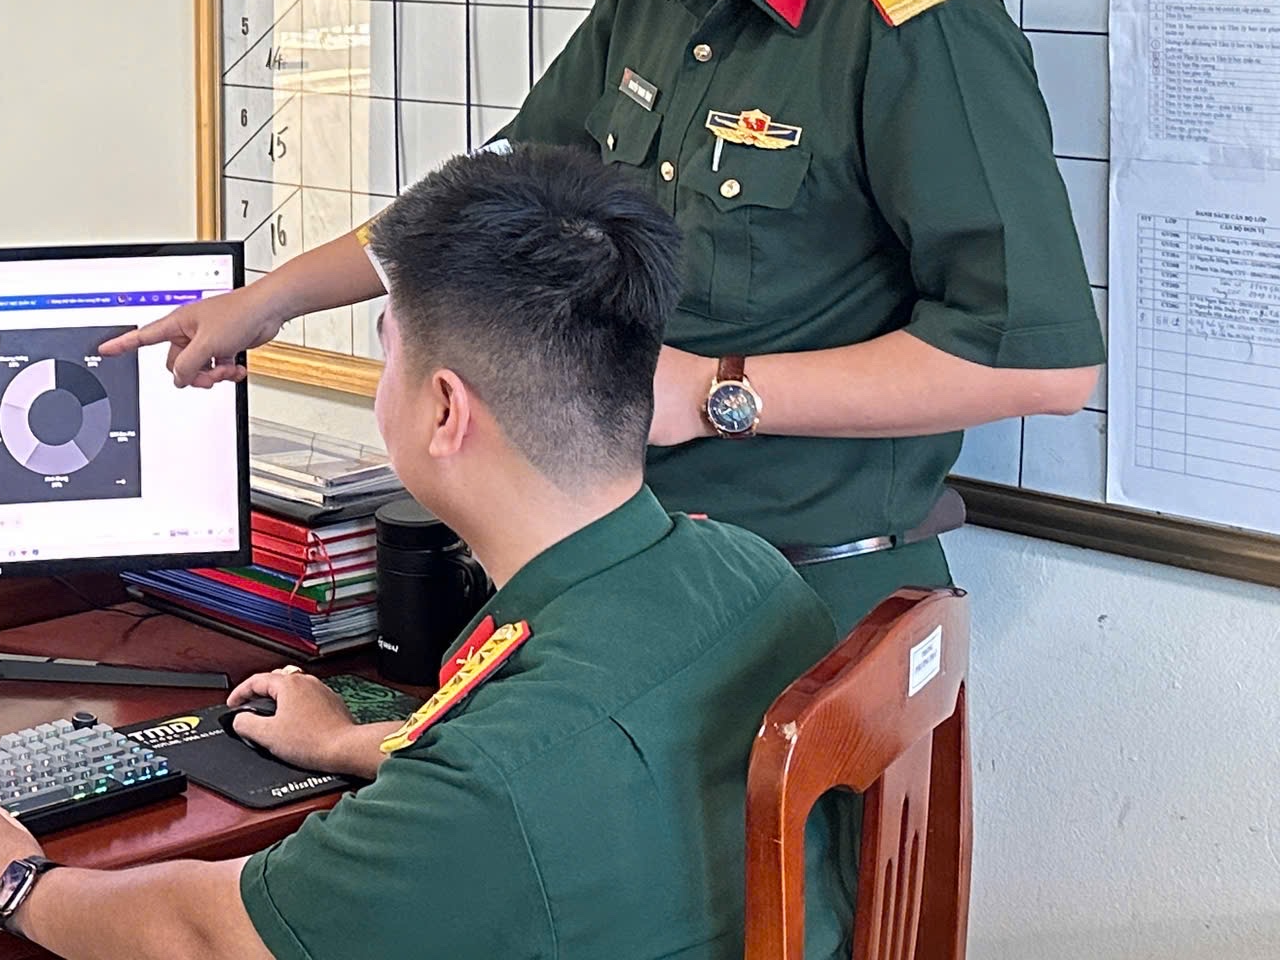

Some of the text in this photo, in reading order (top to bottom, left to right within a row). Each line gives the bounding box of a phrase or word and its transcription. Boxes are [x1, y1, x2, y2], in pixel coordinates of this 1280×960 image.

[241, 18, 248, 35] 5
[240, 108, 248, 127] 6
[268, 126, 288, 162] 15
[241, 200, 248, 218] 7
[271, 215, 287, 256] 16
